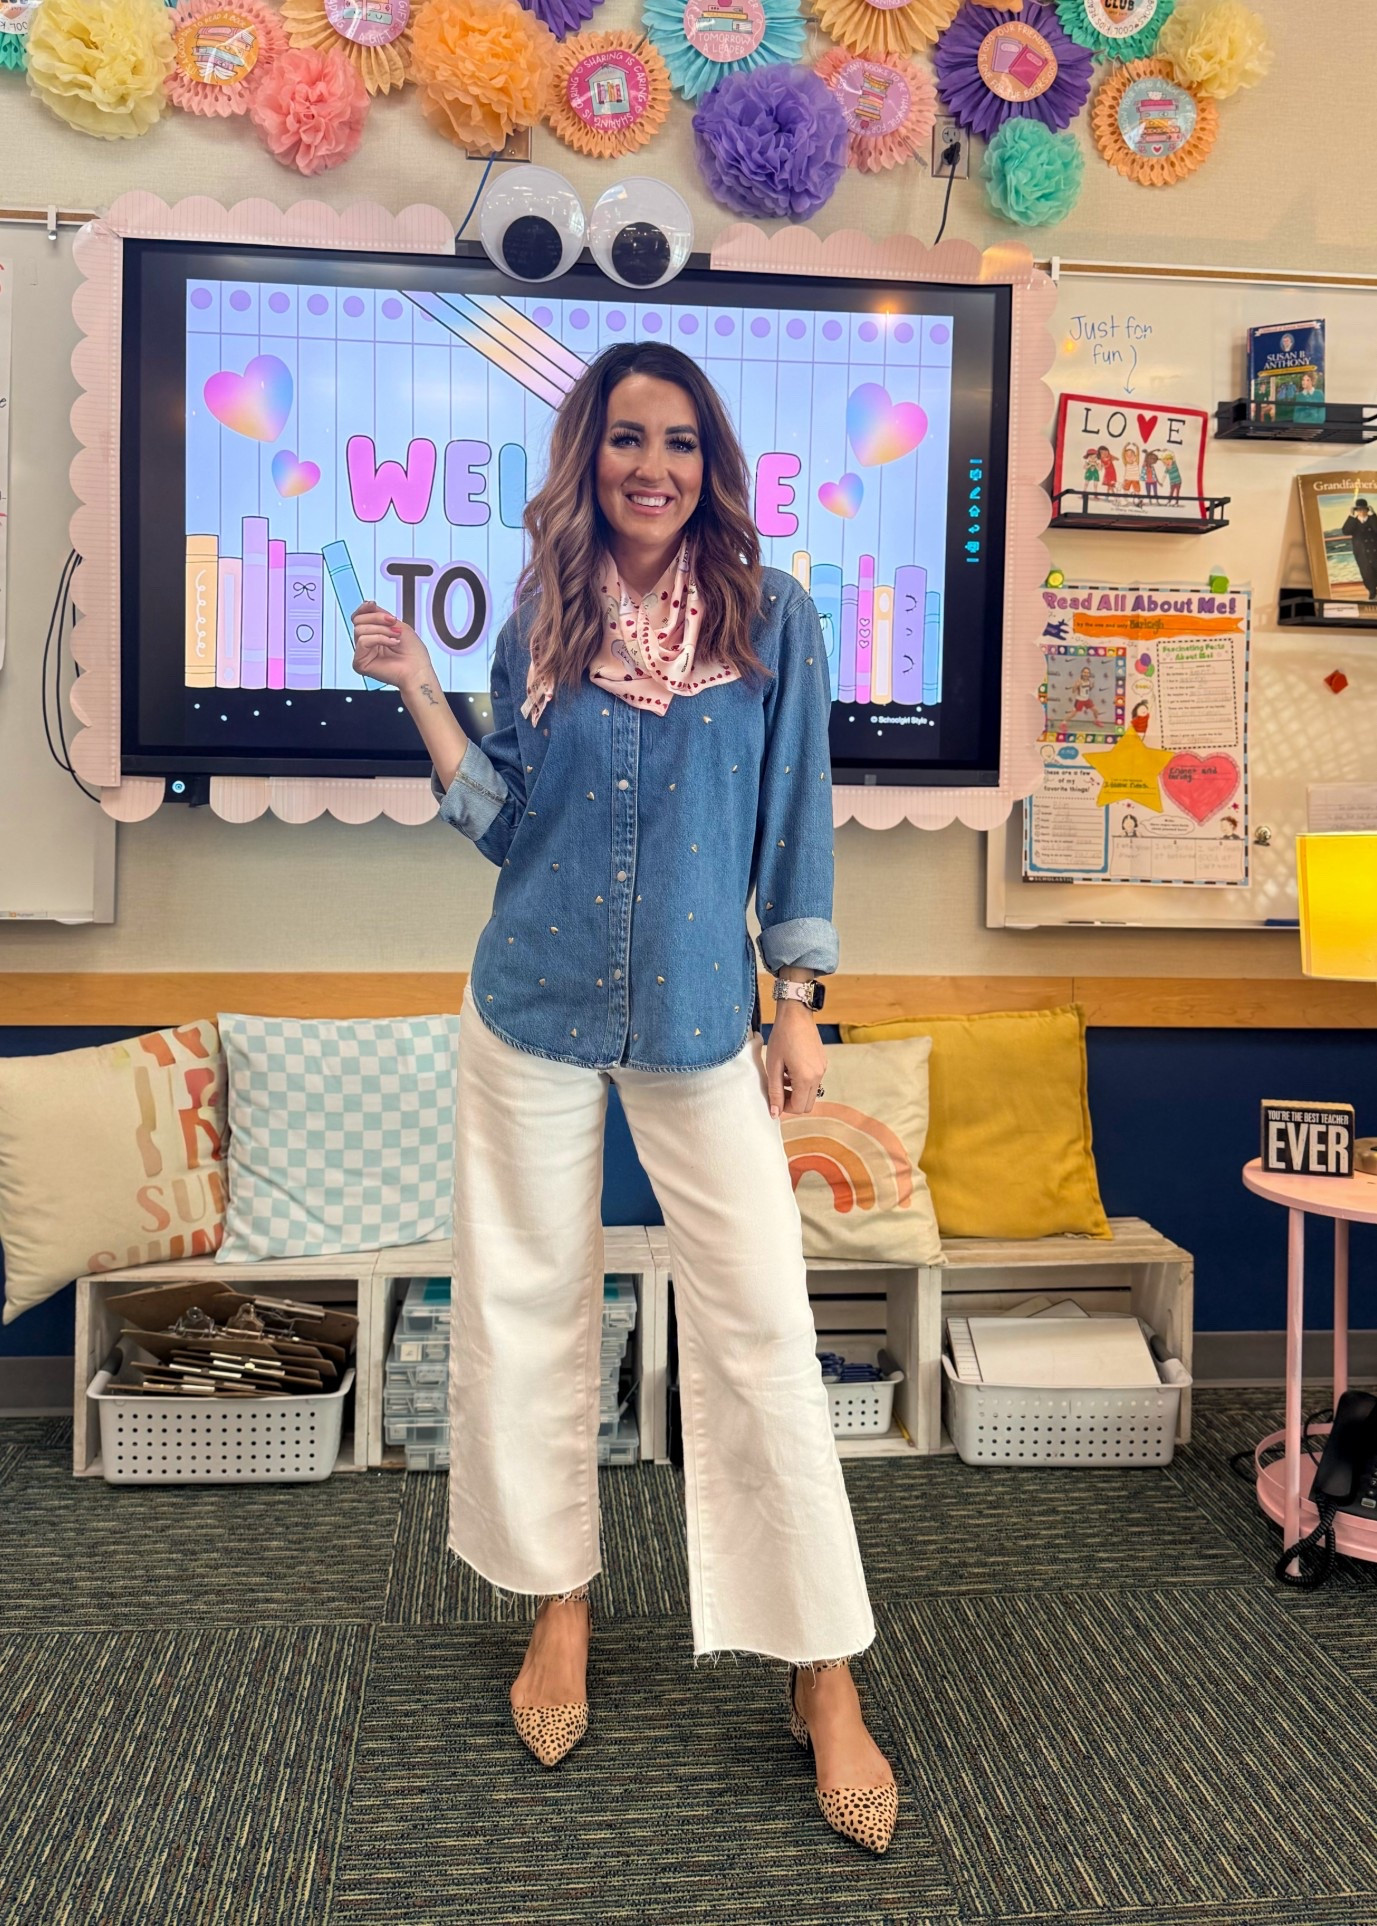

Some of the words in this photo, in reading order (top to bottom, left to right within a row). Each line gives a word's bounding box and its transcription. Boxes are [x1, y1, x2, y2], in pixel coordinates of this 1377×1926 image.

[368, 28, 392, 44] GIFT
[699, 32, 752, 46] TOMORROW
[997, 24, 1015, 36] OUR
[703, 42, 709, 53] A
[712, 43, 745, 55] LEADER
[583, 51, 624, 69] SHARING
[625, 56, 635, 66] IS
[633, 65, 648, 102] CARING
[582, 109, 593, 120] IS
[593, 112, 634, 128] SHARING
[1069, 314, 1121, 341] Just
[1092, 343, 1123, 365] fun
[1263, 356, 1312, 370] ANTHONY
[1266, 351, 1298, 362] SUSAN
[383, 560, 490, 653] TO
[1042, 591, 1093, 611] Read
[1096, 593, 1127, 612] All
[1130, 595, 1194, 613] About
[1197, 597, 1237, 615] Me!
[1268, 1109, 1291, 1121] YOU'RE
[1291, 1111, 1304, 1122] THE
[1304, 1112, 1320, 1124] BEST
[1321, 1113, 1349, 1126] TEACHER
[1268, 1121, 1349, 1174] EVER
